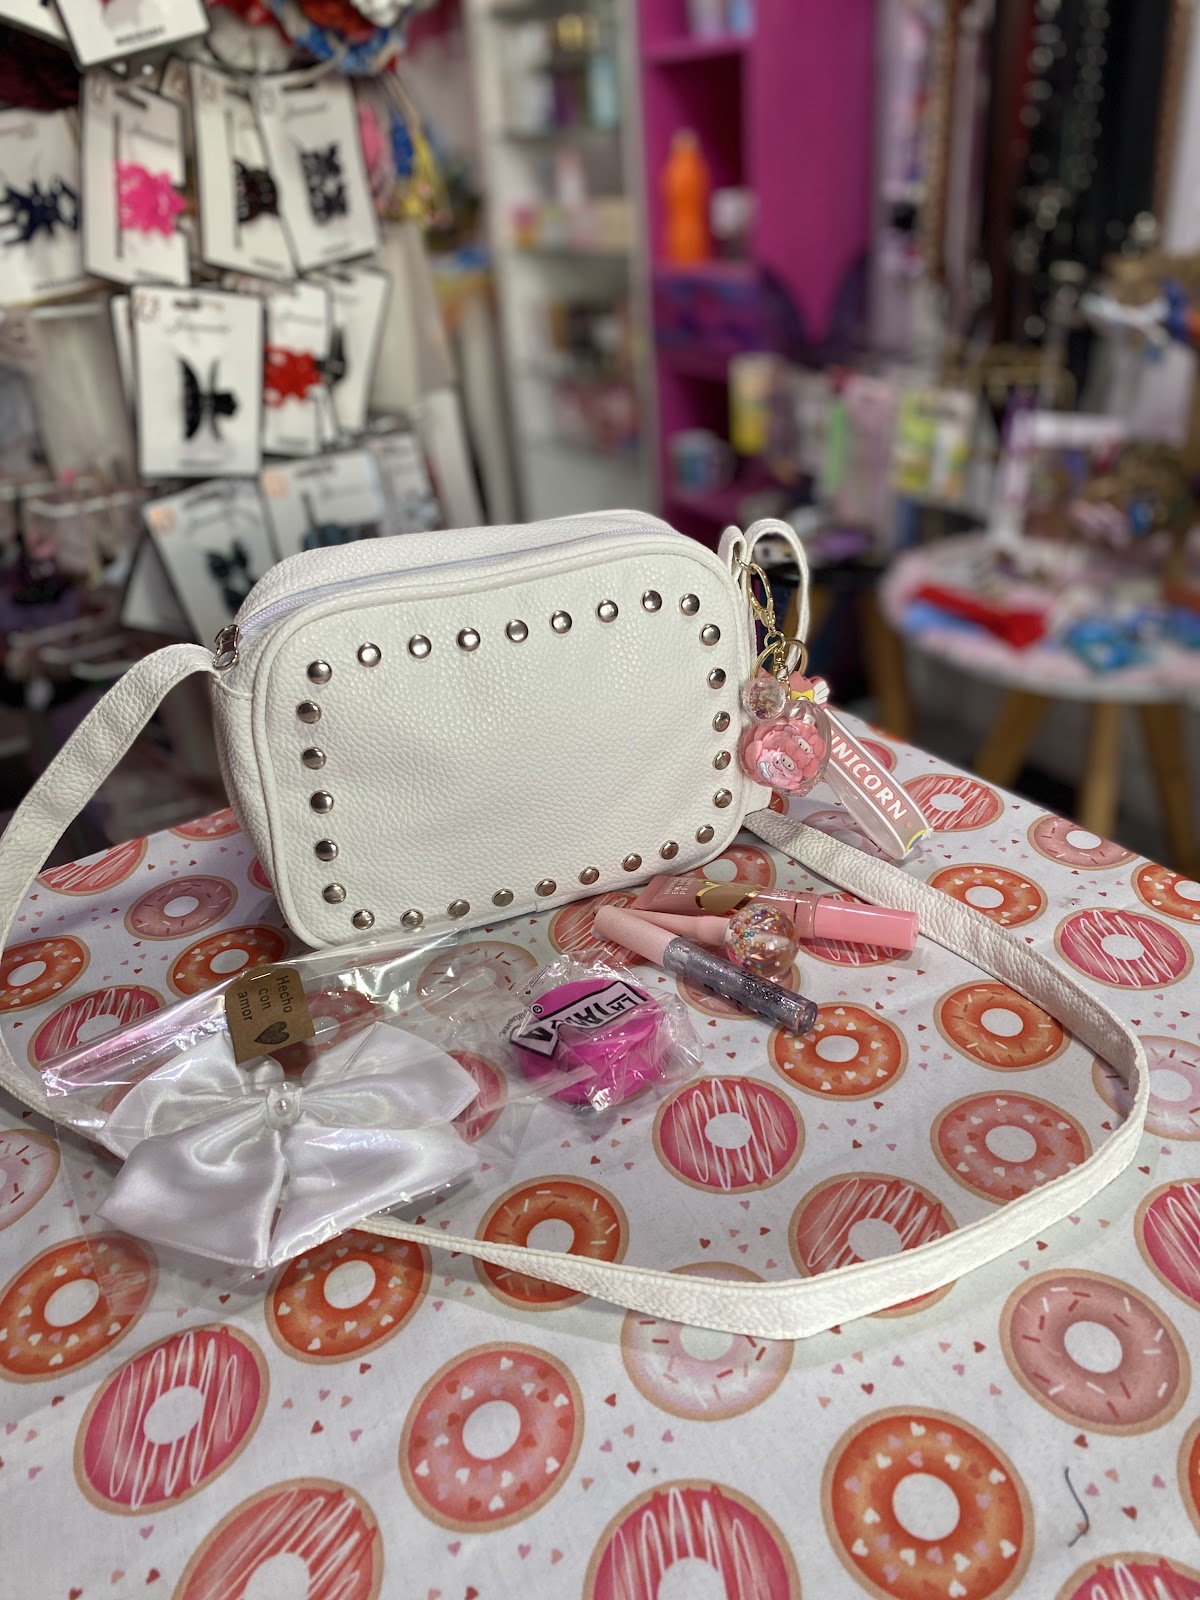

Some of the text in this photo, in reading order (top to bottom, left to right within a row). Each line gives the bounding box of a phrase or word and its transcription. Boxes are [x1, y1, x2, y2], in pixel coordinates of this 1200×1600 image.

[237, 991, 253, 1021] amor
[258, 988, 272, 1010] con
[276, 975, 293, 1013] Hecho
